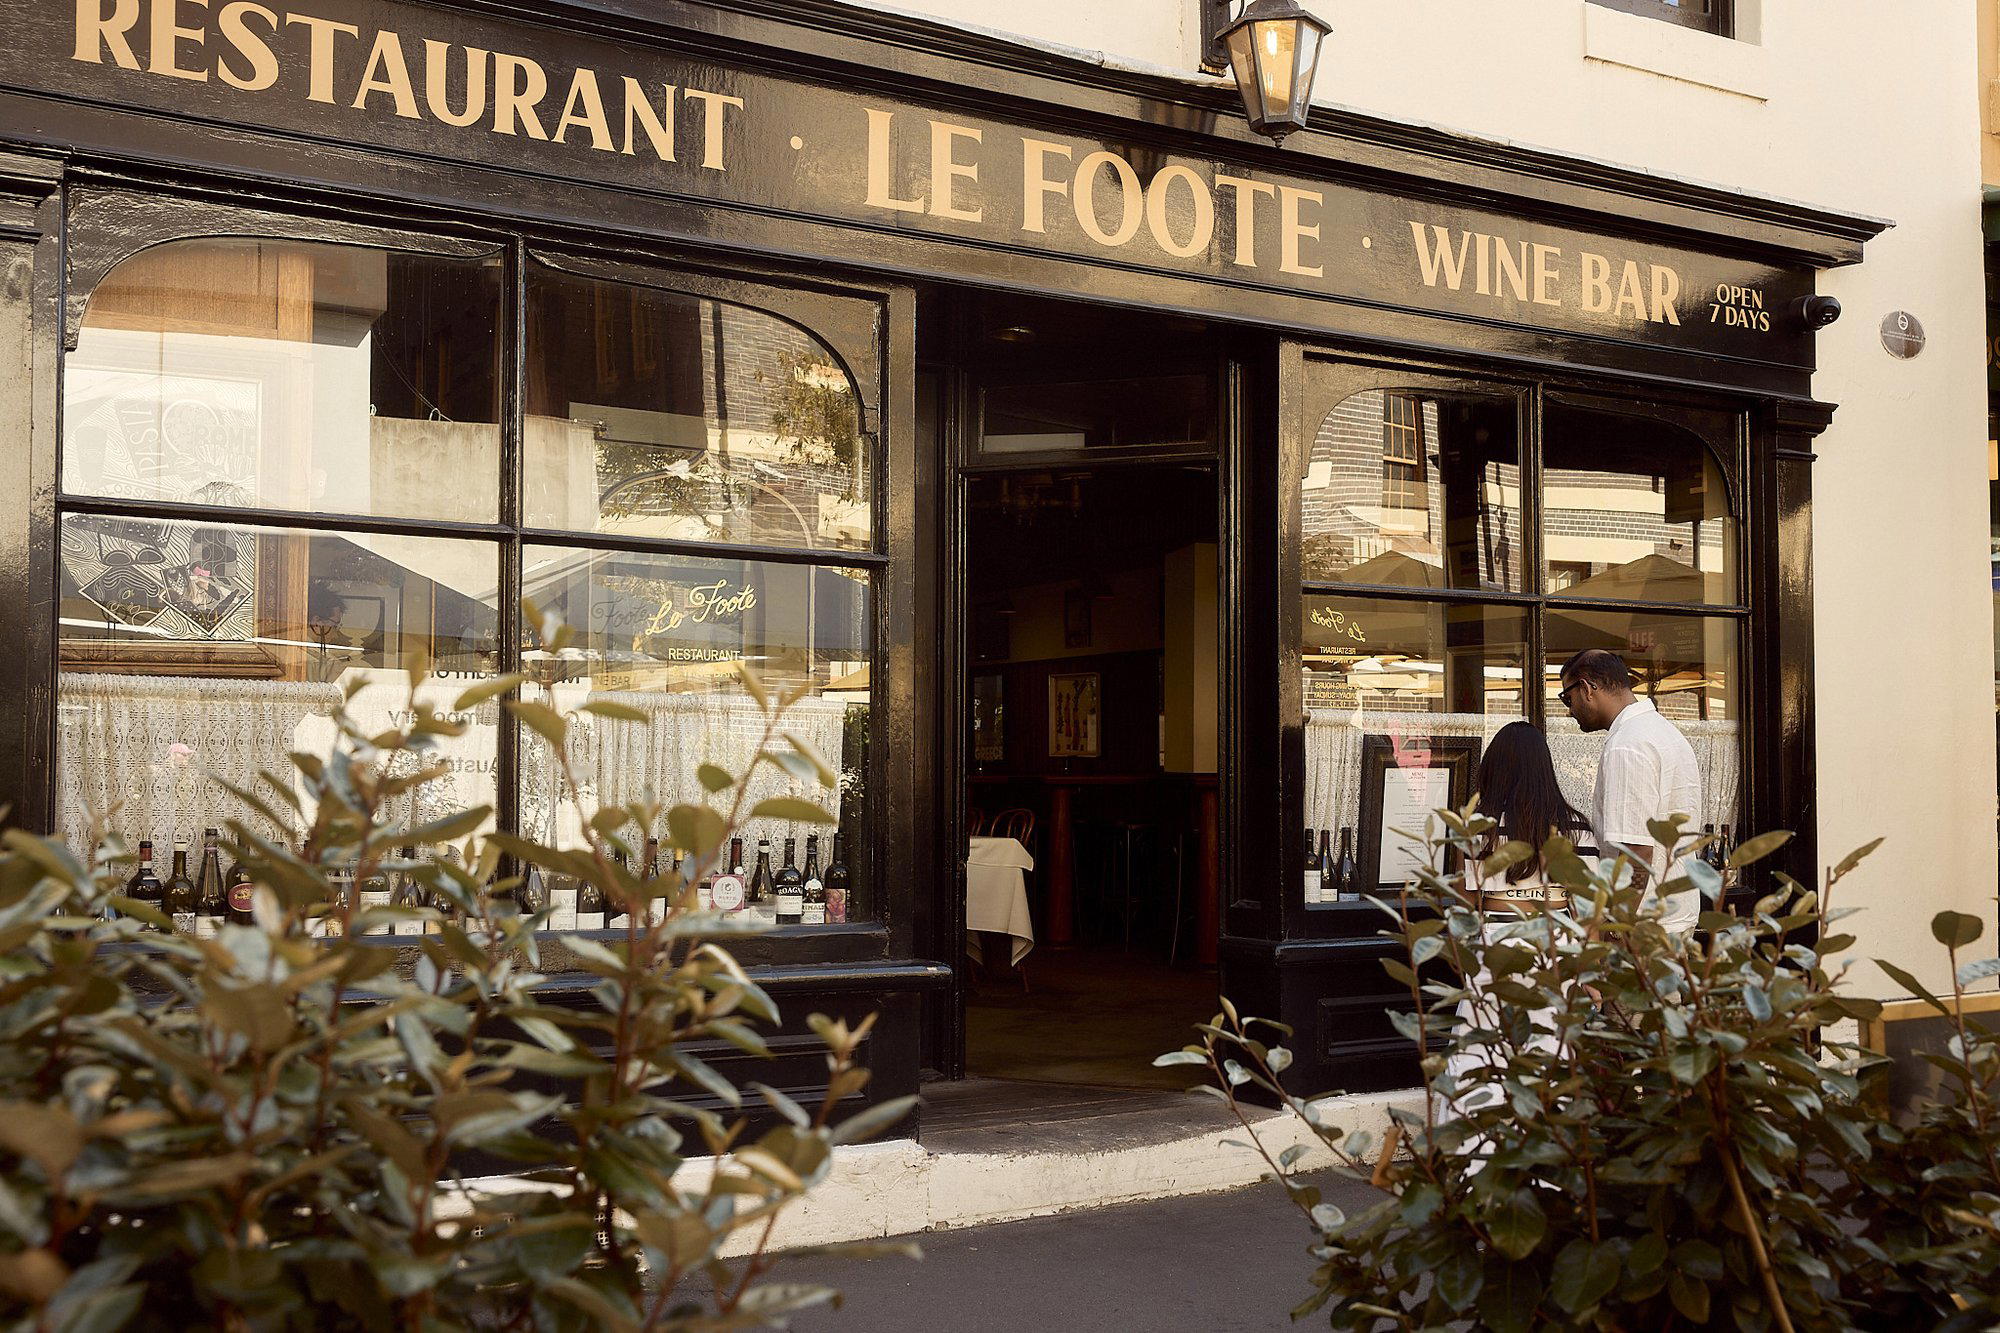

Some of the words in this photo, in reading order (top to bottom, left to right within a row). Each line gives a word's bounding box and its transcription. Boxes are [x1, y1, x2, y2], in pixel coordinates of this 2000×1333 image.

[71, 0, 745, 171] RESTAURANT
[862, 107, 983, 222] LE
[1019, 136, 1324, 278] FOOTE
[1408, 220, 1563, 306] WINE
[1580, 251, 1681, 326] BAR
[1716, 283, 1763, 310] OPEN
[1709, 303, 1720, 325] 7
[1724, 305, 1771, 333] DAYS
[645, 600, 685, 636] Le
[689, 578, 757, 623] Foote
[668, 647, 741, 662] RESTAURANT
